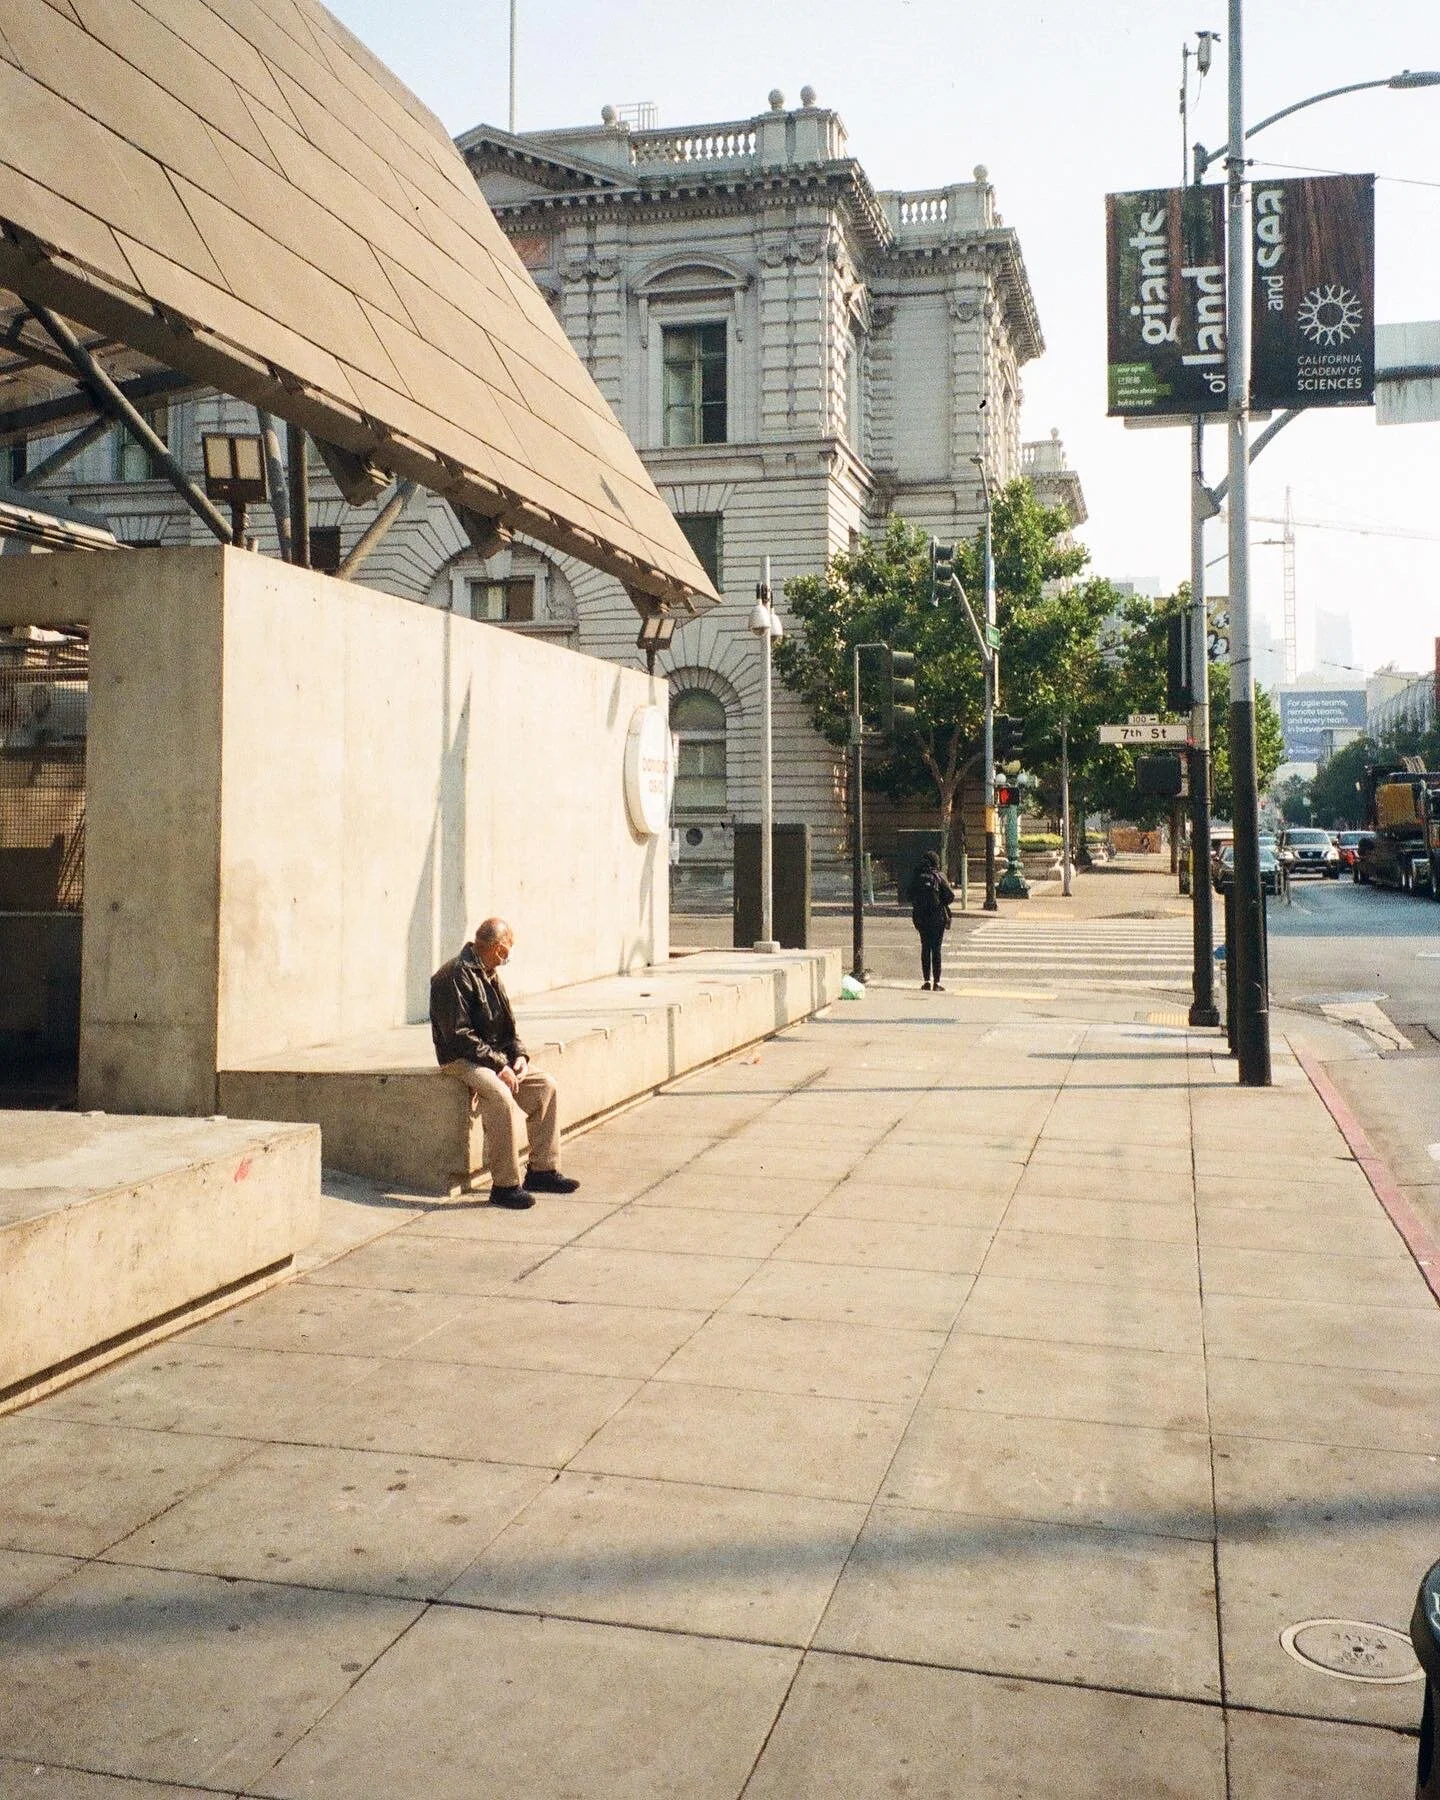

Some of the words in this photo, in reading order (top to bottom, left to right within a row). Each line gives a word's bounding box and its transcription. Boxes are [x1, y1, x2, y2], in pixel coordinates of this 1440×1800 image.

[1257, 189, 1285, 268] sea
[1129, 208, 1182, 346] giants
[1261, 275, 1284, 311] and
[1181, 265, 1226, 366] land
[1297, 354, 1362, 365] CALIFORNIA
[1297, 366, 1347, 377] ACADEMY
[1349, 366, 1362, 375] OF
[1203, 373, 1226, 393] of
[1297, 377, 1362, 390] SCIENCES
[1132, 716, 1147, 724] 100
[1121, 728, 1142, 740] 7th
[1151, 728, 1167, 739] St
